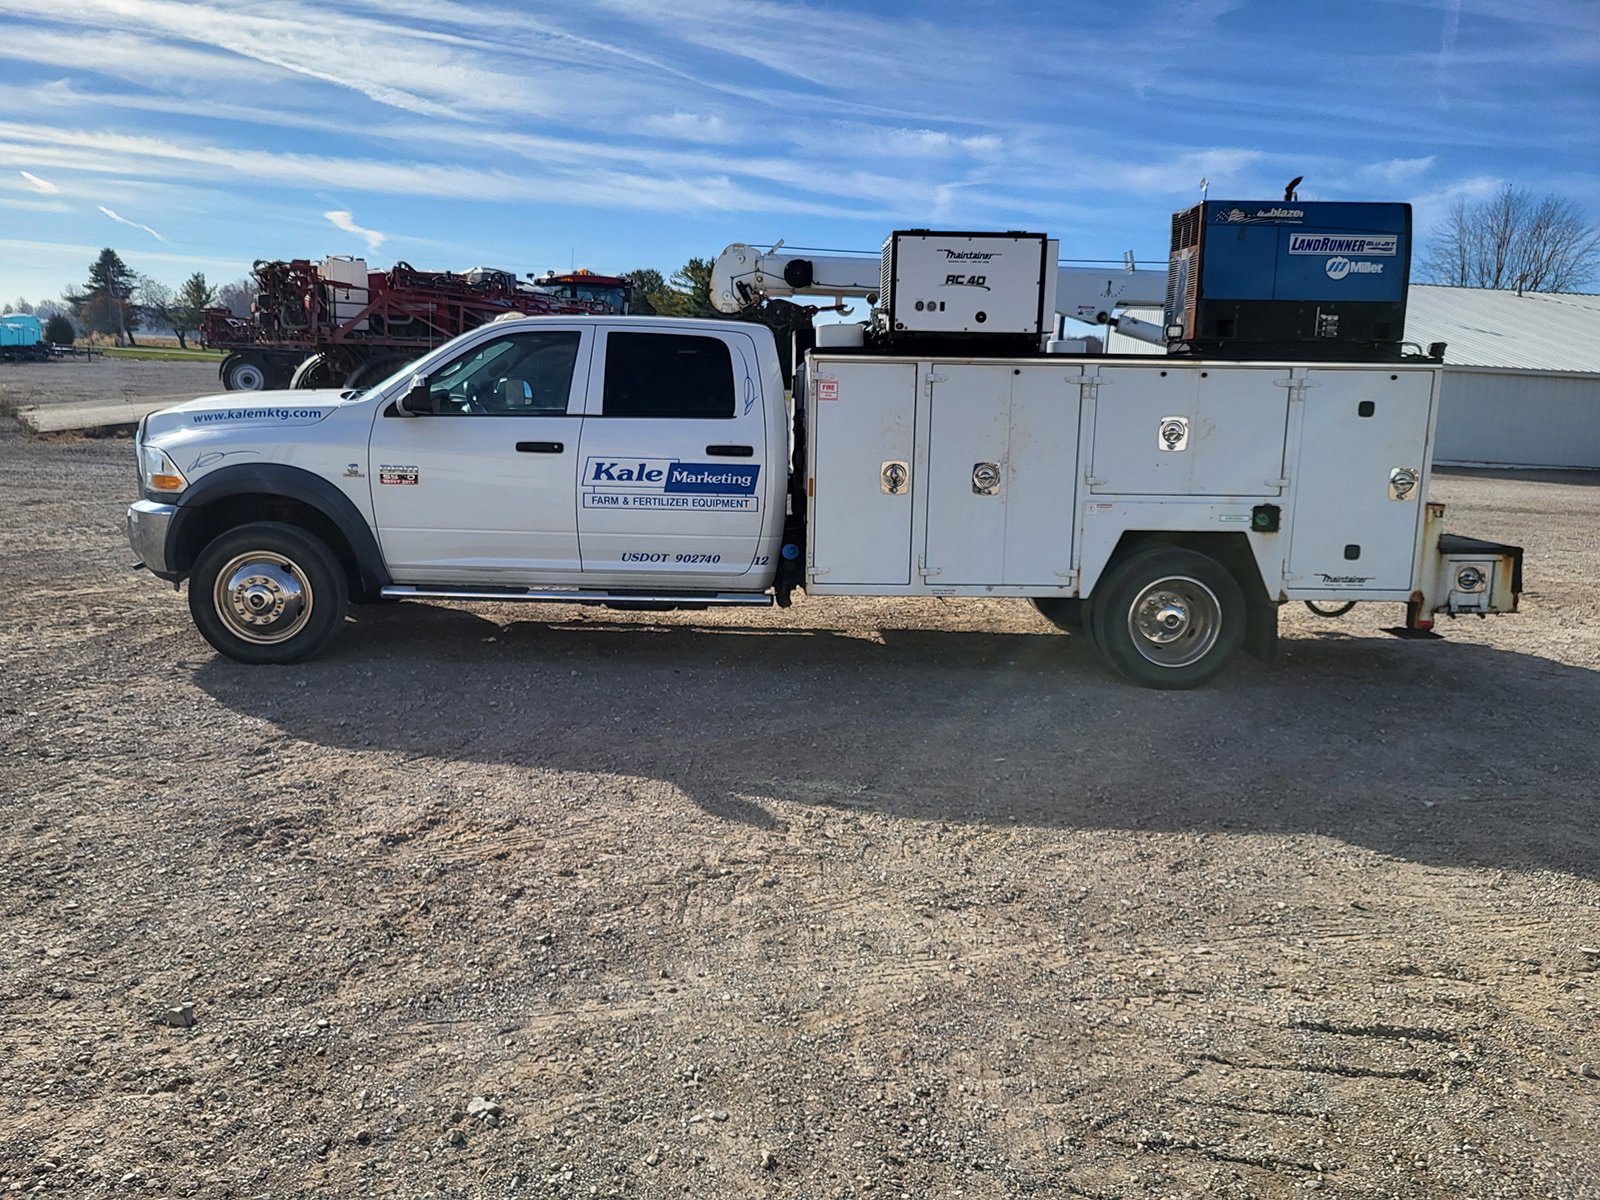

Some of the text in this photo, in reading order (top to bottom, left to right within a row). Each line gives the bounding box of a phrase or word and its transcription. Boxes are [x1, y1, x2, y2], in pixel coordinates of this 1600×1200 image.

[938, 248, 1001, 260] Maintainer
[1350, 261, 1383, 273] Miller
[967, 275, 986, 286] 40
[193, 408, 322, 423] www.kalemktg.com
[591, 462, 752, 487] Kale Marketing
[592, 496, 750, 508] FARM & FERTILIZER EQUIPMENT
[621, 552, 769, 566] USDOT 902740 12
